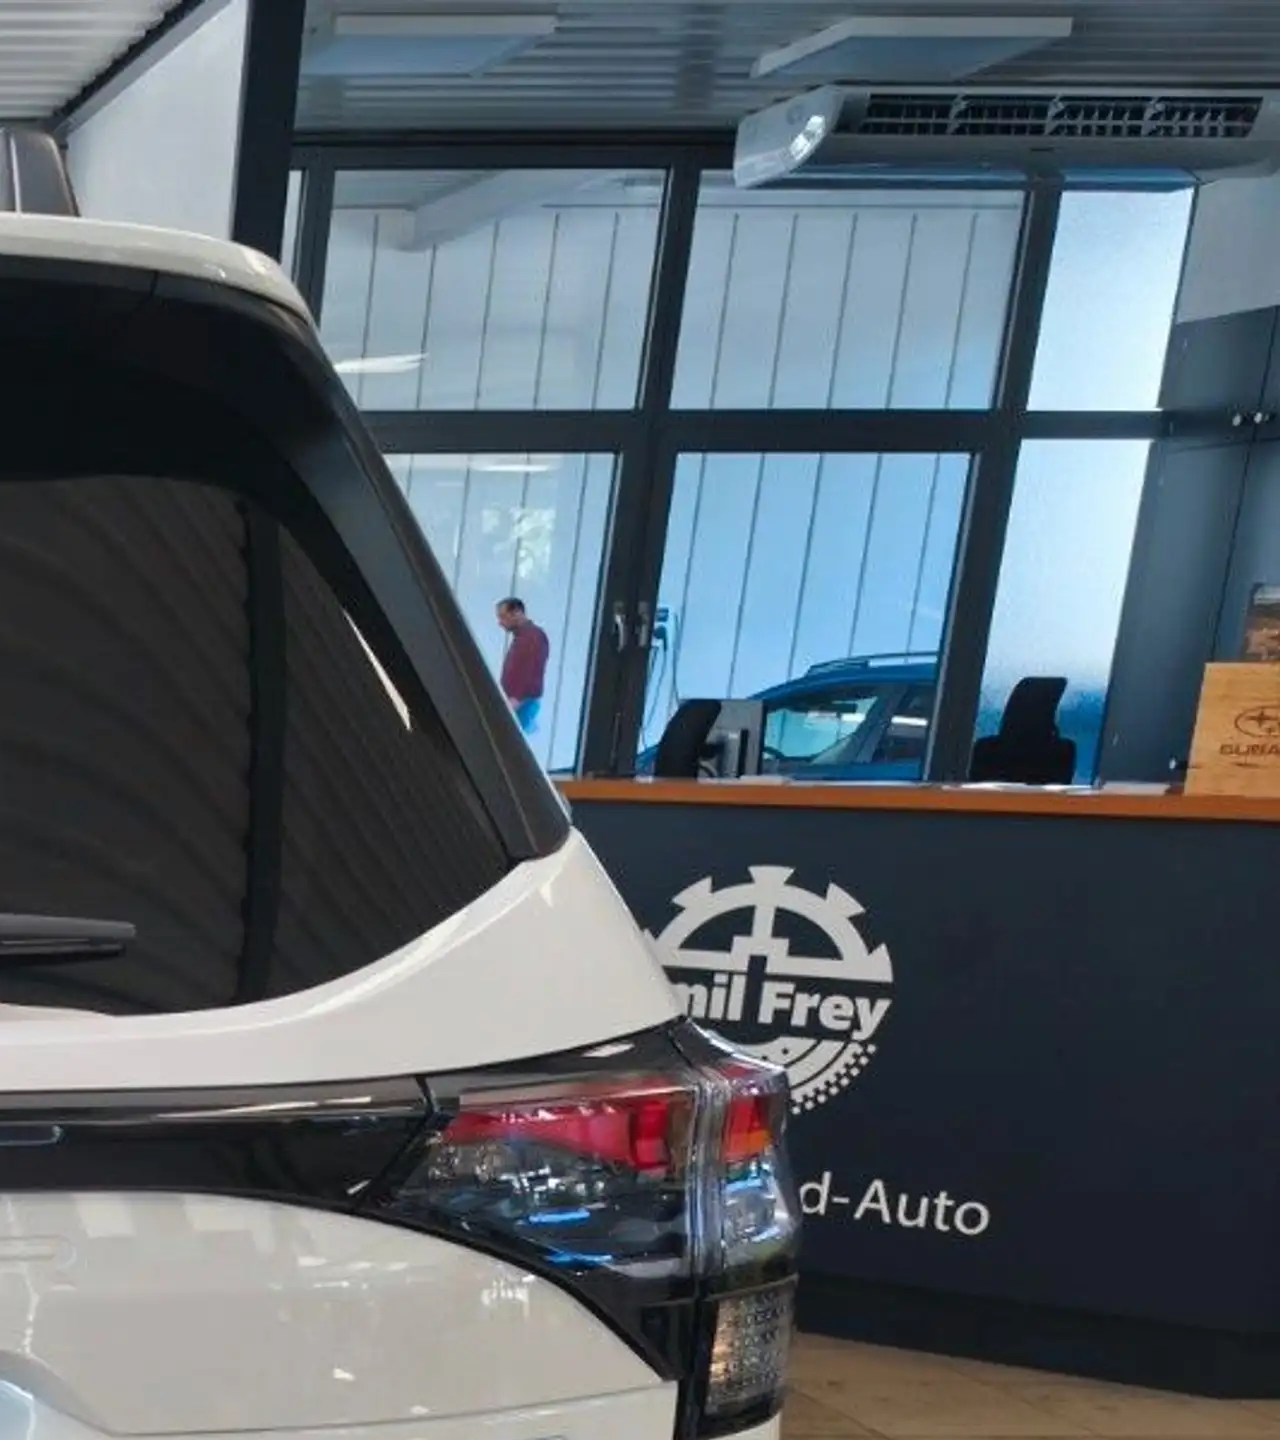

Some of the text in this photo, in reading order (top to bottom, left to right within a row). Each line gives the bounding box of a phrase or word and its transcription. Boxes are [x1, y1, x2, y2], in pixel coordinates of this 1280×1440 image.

[671, 972, 893, 1041] mil Frey
[799, 1171, 990, 1235] d-Auto
